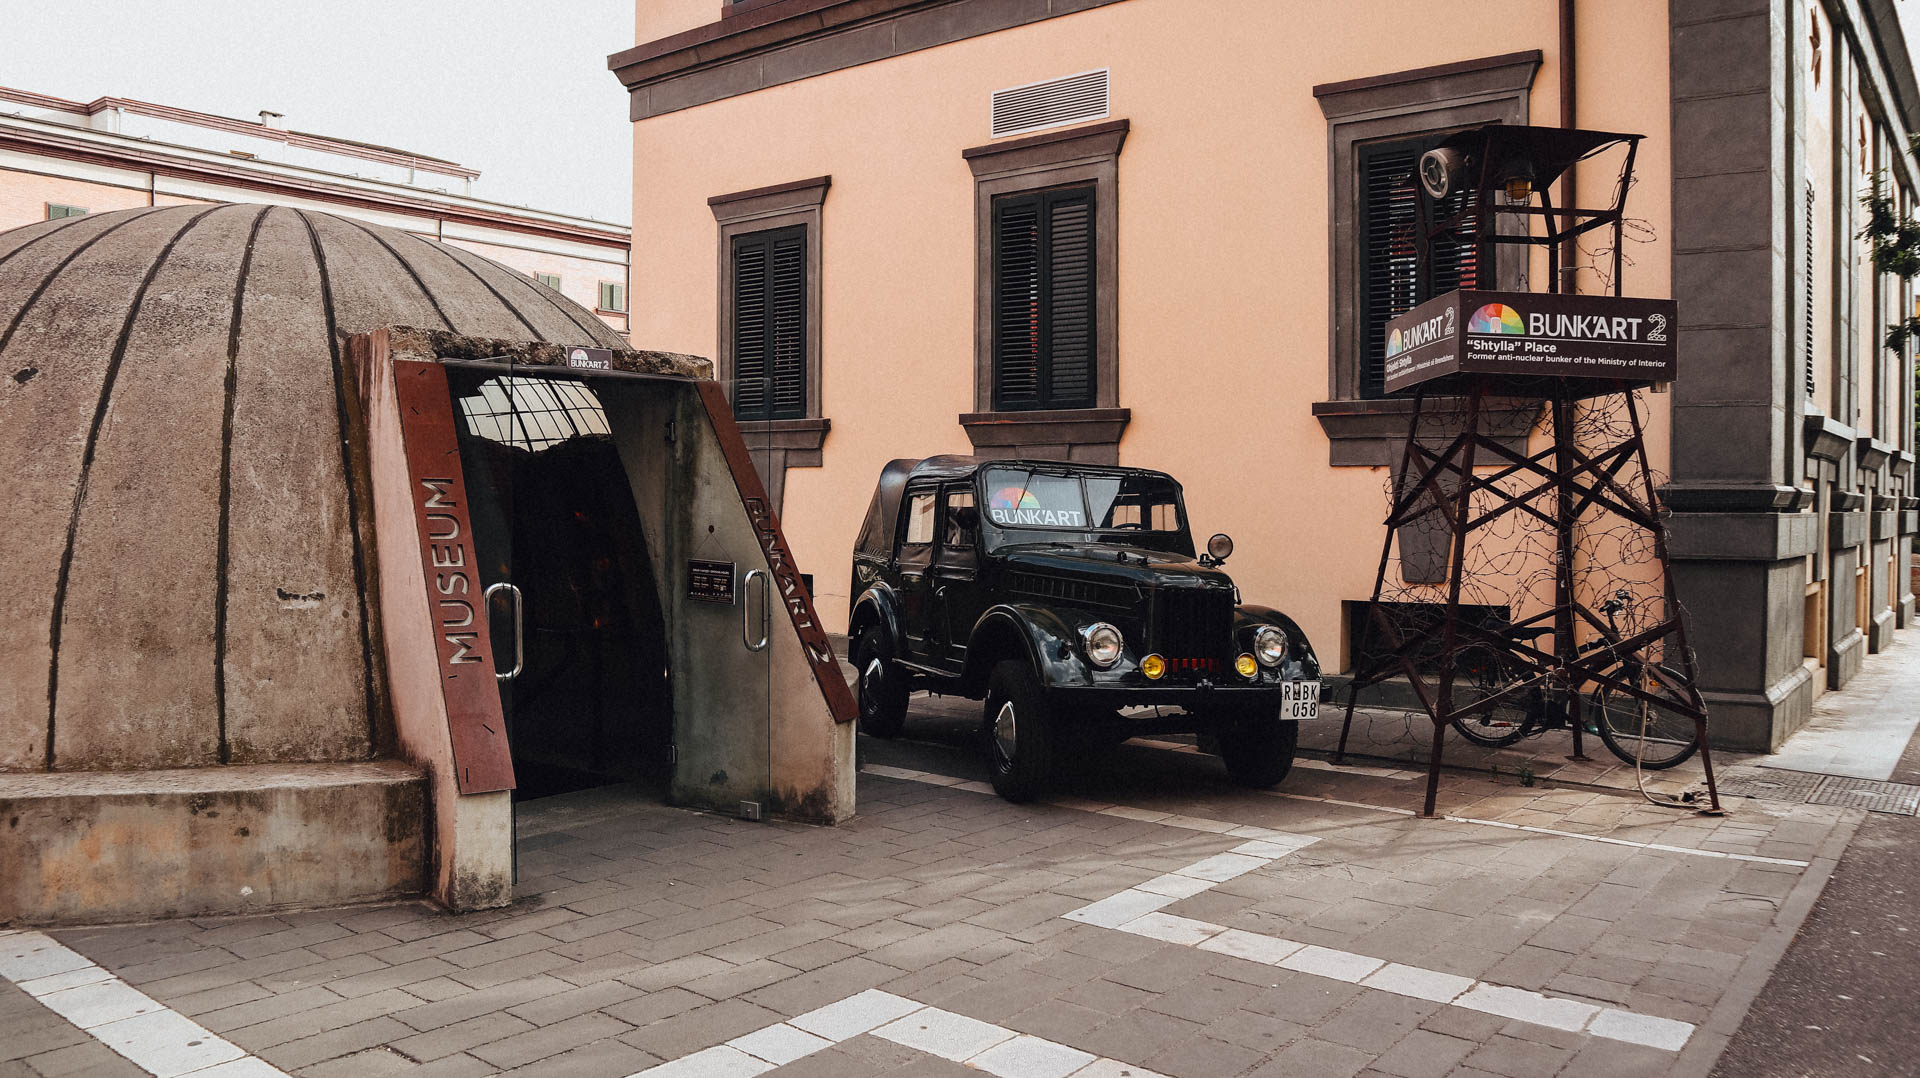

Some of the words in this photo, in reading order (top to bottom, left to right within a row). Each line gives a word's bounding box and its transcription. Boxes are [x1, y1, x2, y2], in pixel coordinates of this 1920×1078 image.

[1445, 306, 1455, 336] 2
[1529, 312, 1643, 340] BUNK'ART
[1647, 313, 1667, 341] 2
[1525, 342, 1557, 353] Place
[603, 361, 609, 369] 2
[1467, 352, 1496, 360] Former
[1497, 353, 1544, 362] anti-nuclear
[1545, 355, 1572, 363] bunker
[1573, 356, 1582, 364] of
[1583, 356, 1596, 365] the
[1597, 357, 1627, 367] Ministry
[1628, 358, 1637, 366] of
[1638, 359, 1666, 367] Interior
[991, 509, 1081, 526] BUNK'ART
[421, 478, 483, 665] MUSEUM
[1285, 685, 1291, 700] R
[1293, 702, 1316, 717] 058
